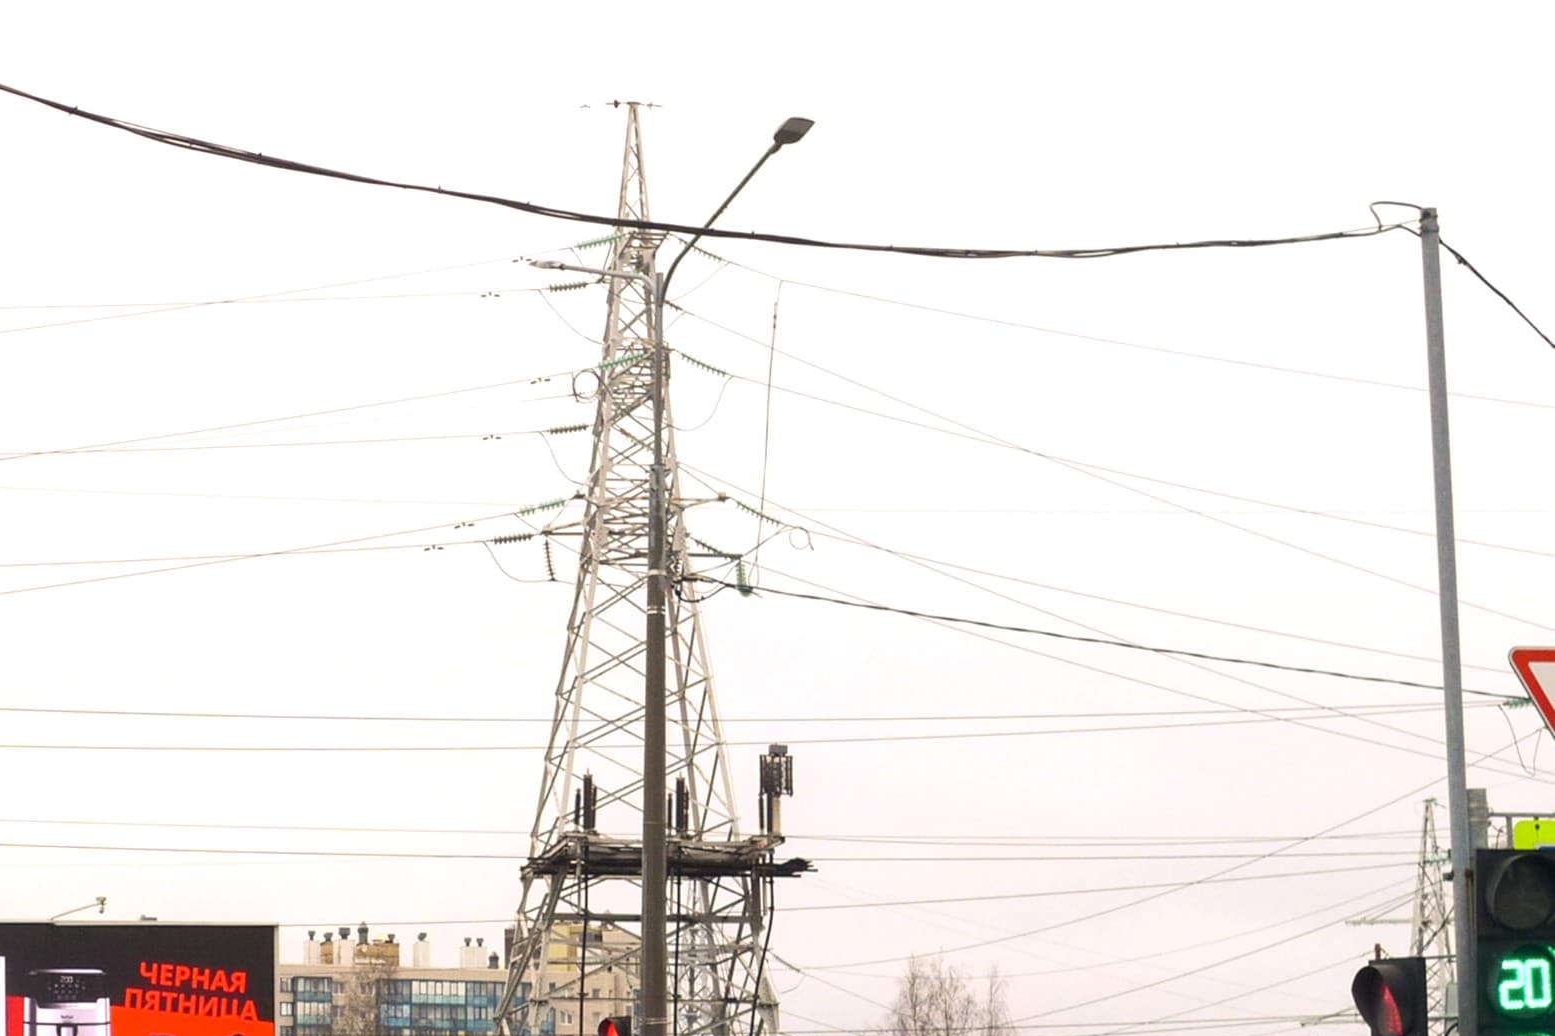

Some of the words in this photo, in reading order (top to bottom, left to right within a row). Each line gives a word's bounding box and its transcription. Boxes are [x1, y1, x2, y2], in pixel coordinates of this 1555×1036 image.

[140, 961, 247, 994] ЧЕРНАЯ
[1499, 959, 1552, 1011] 20
[124, 987, 259, 1022] ПЯТНИЦА
